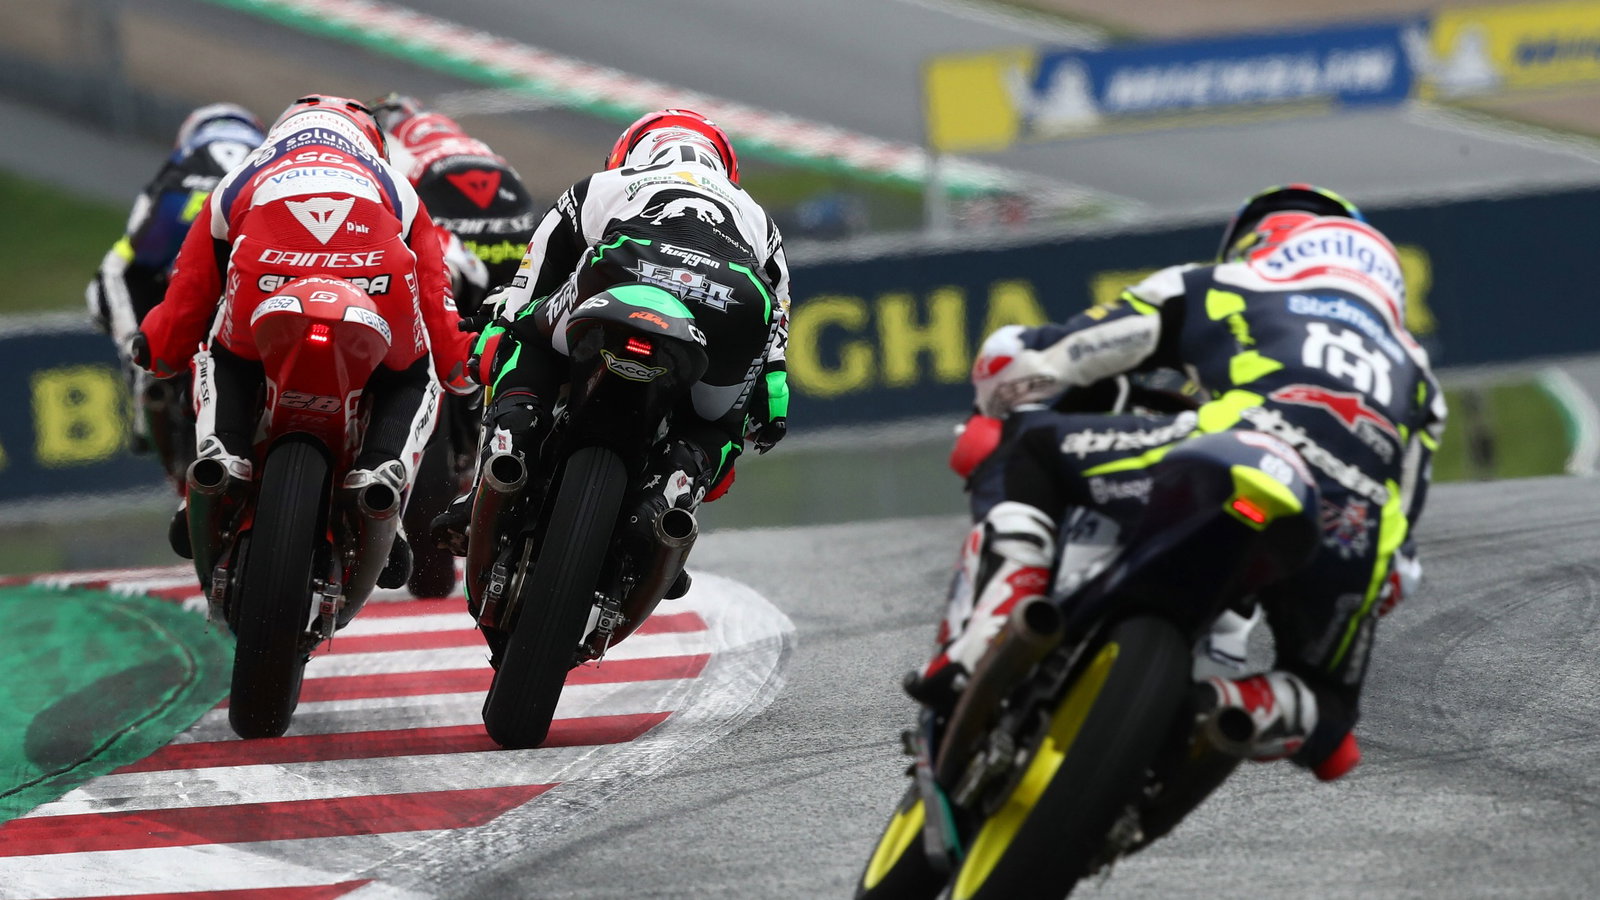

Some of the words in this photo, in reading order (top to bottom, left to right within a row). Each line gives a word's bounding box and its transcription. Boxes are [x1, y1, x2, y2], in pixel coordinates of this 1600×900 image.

[286, 129, 382, 173] solunion
[272, 167, 369, 188] valresa
[628, 175, 672, 193] Green
[258, 249, 384, 267] DAINESE
[258, 273, 392, 295] GURA
[404, 273, 424, 354] DAINESE
[628, 311, 671, 330] KTM
[785, 279, 1050, 397] GHA
[199, 357, 211, 408] DAINESE
[279, 391, 342, 414] 28
